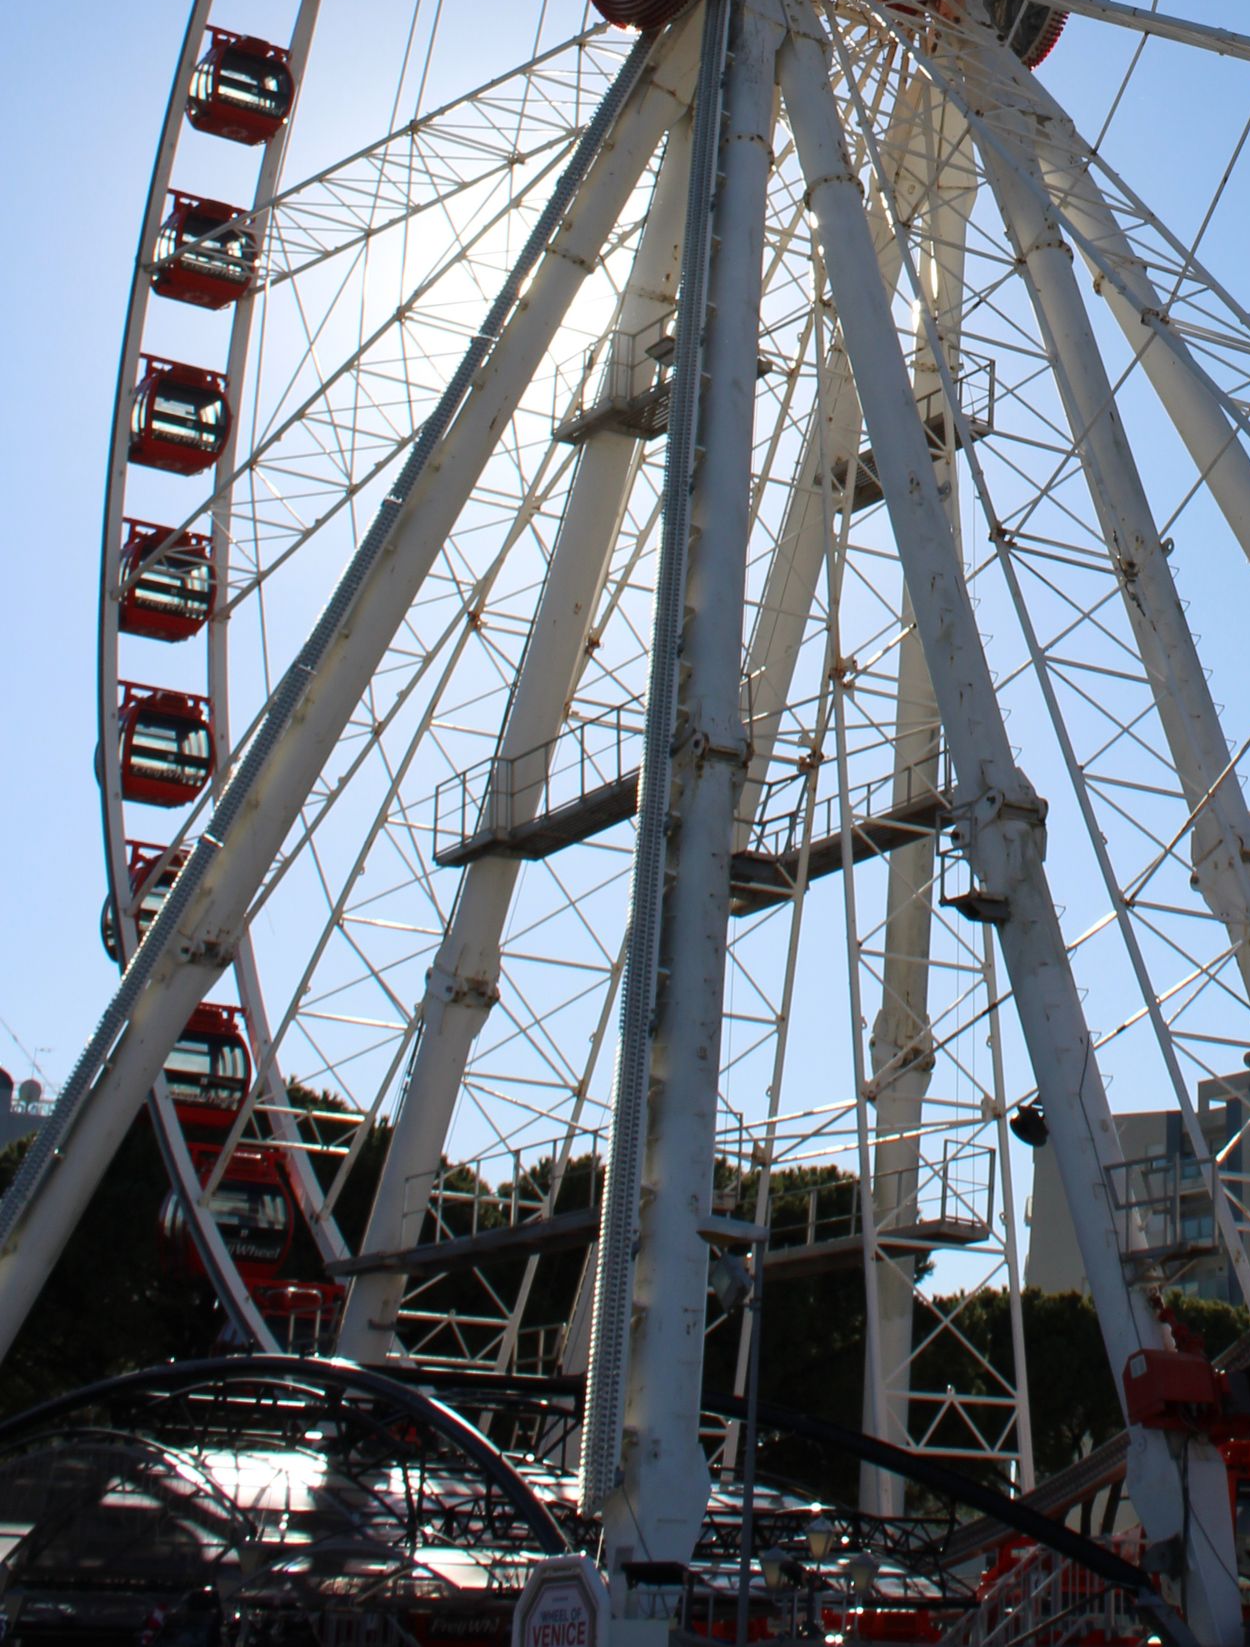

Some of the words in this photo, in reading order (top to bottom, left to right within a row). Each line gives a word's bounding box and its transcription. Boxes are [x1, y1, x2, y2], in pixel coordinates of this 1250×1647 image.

[540, 1608, 568, 1622] WHEEL
[570, 1607, 582, 1620] OF
[532, 1620, 587, 1647] VENICE
